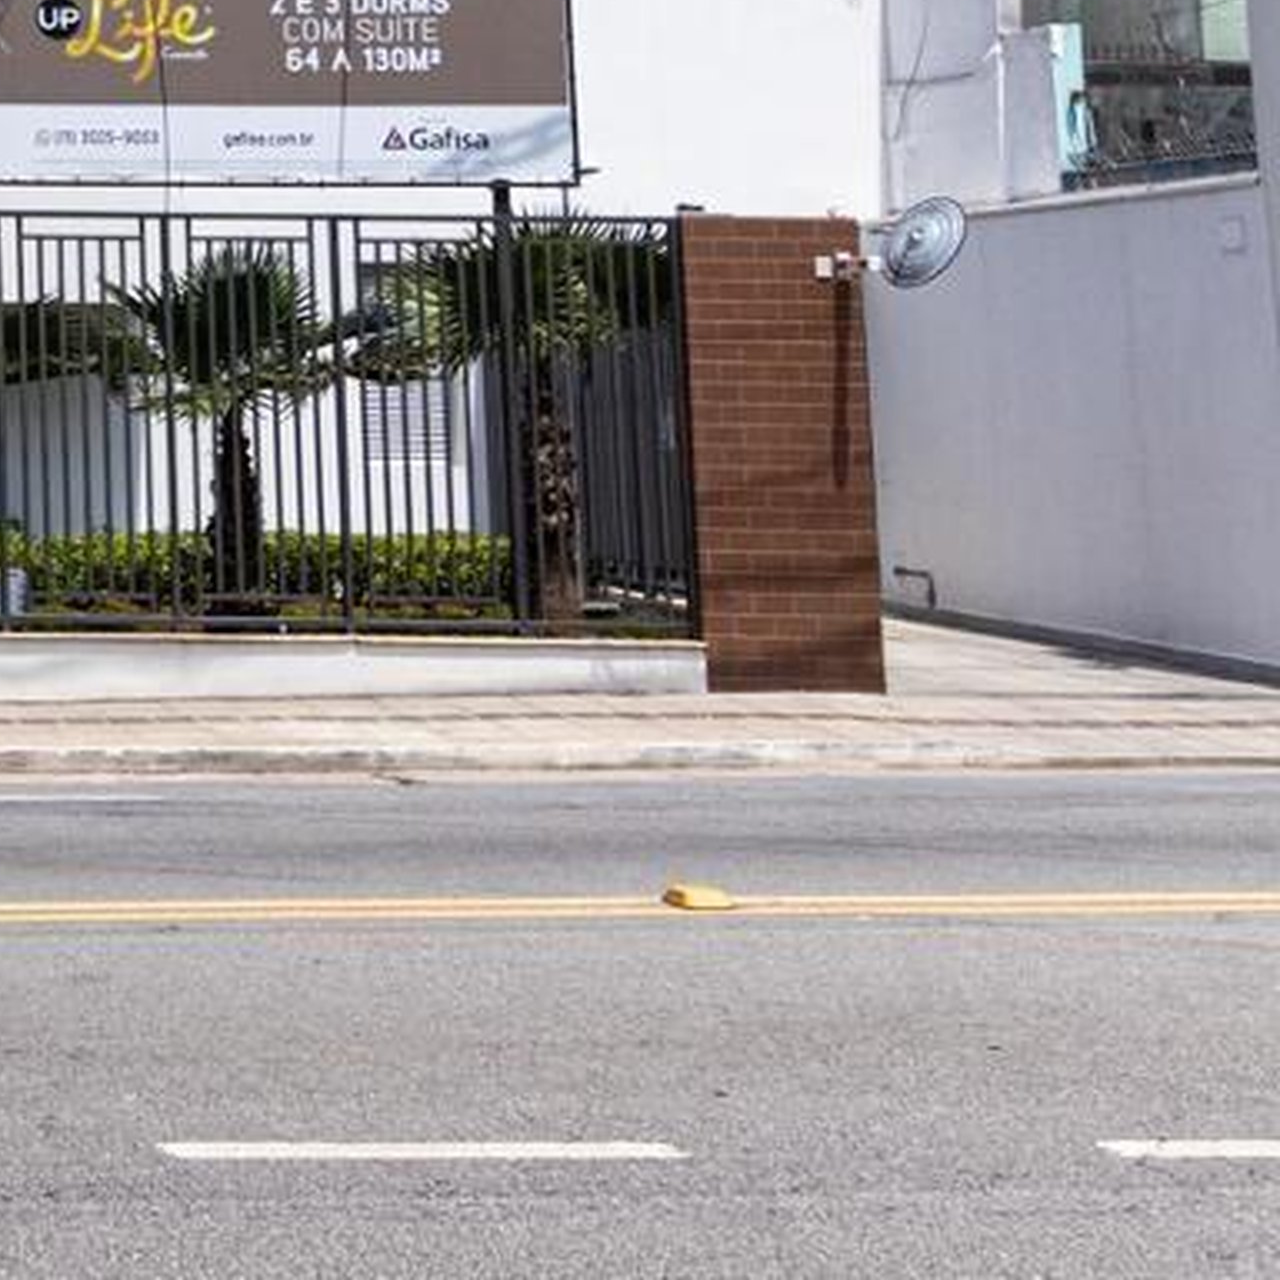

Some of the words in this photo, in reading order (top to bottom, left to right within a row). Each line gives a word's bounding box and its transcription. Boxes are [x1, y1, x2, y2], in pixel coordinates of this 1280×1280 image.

[38, 5, 81, 31] UP
[281, 17, 345, 44] COM
[354, 17, 440, 44] SUITE
[285, 47, 320, 72] 64
[408, 125, 491, 151] Gafisa
